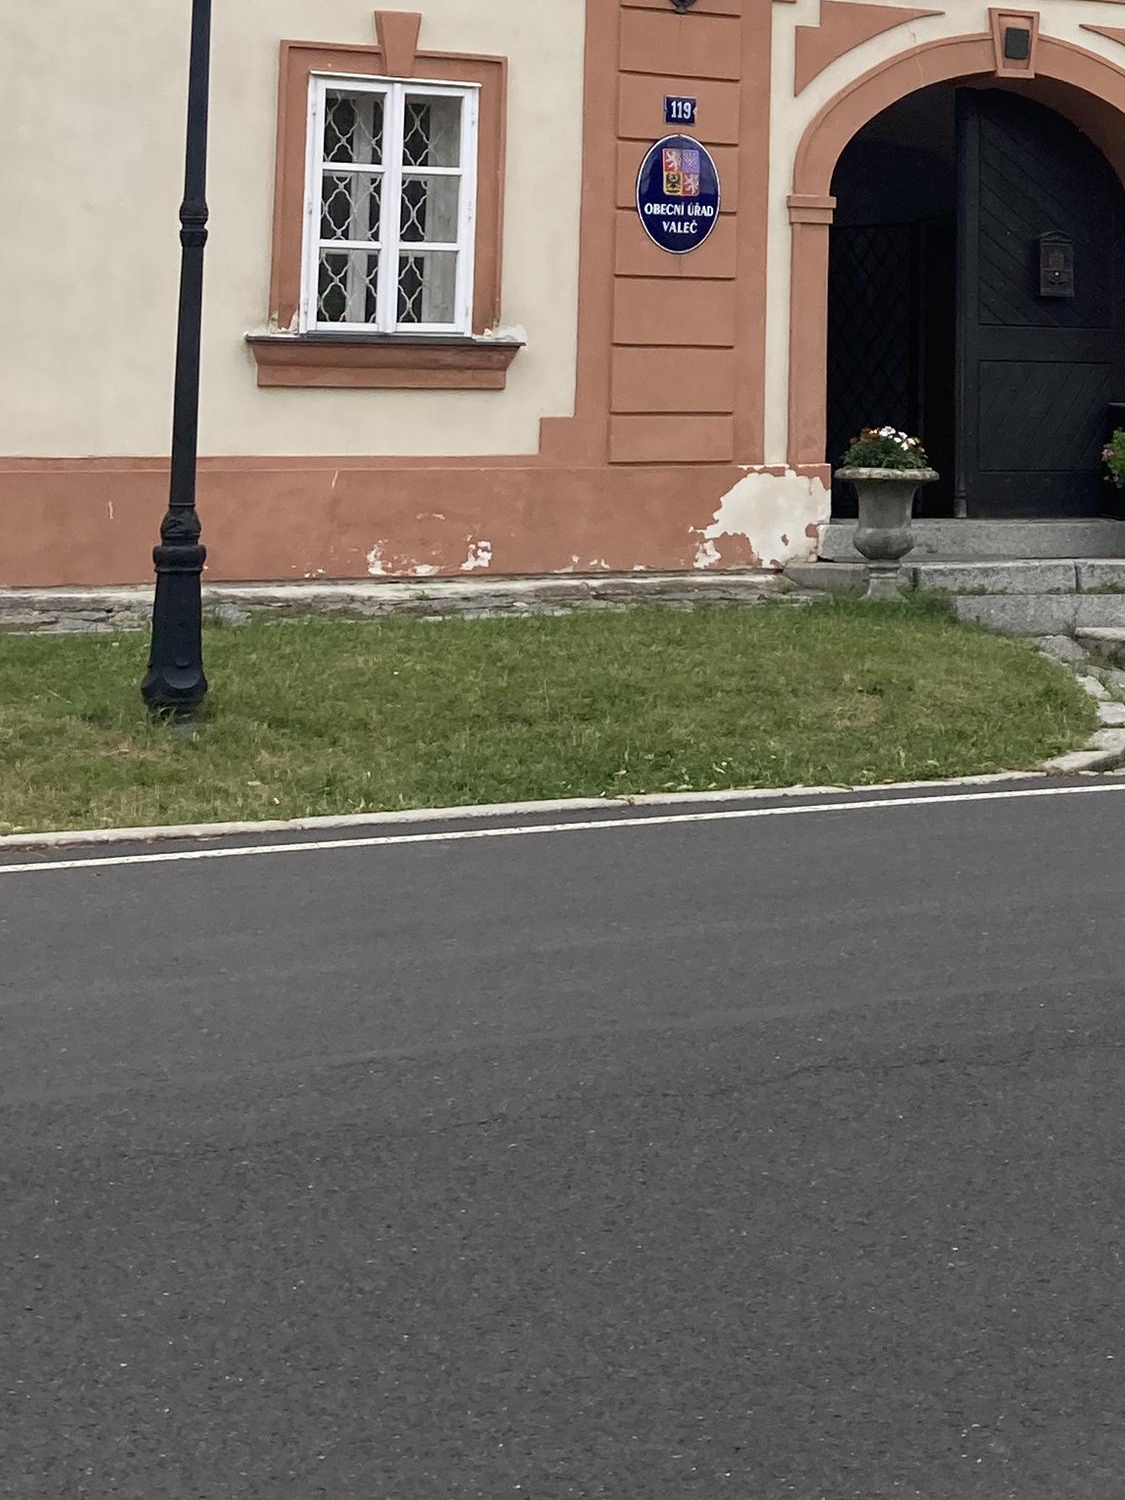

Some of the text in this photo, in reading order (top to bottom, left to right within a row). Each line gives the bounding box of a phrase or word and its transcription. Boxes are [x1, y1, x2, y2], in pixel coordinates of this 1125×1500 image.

[671, 100, 692, 119] 119
[644, 201, 714, 217] OBECNÍ ÚŘAD
[662, 220, 698, 233] VALEČ
